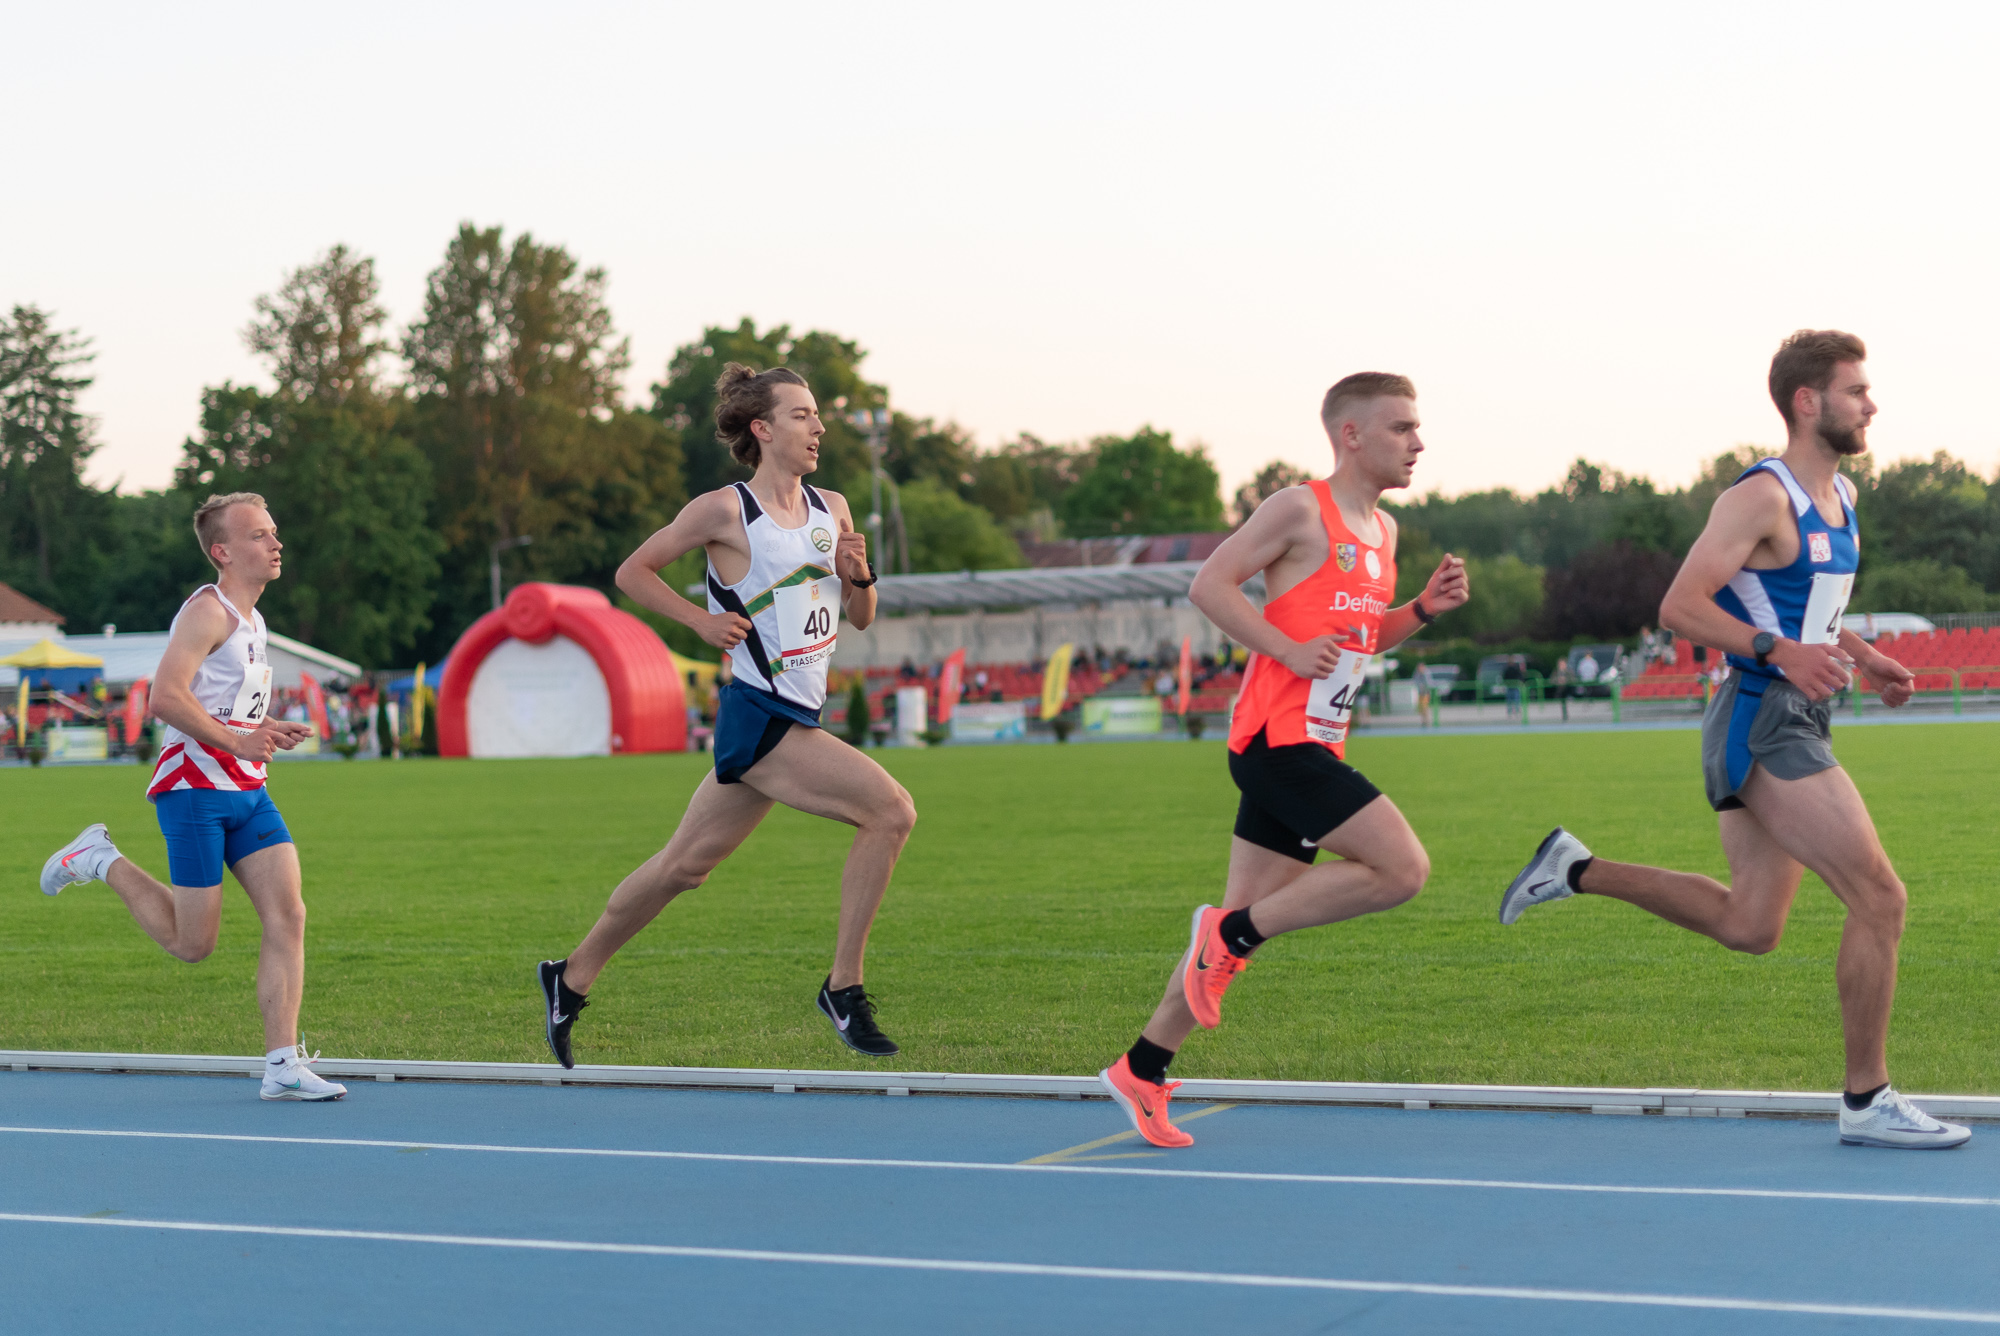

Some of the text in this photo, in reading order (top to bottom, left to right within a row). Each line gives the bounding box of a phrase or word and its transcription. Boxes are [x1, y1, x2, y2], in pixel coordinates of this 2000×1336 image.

[813, 531, 828, 542] RKS
[804, 606, 830, 640] 40
[1826, 606, 1844, 640] 4
[247, 692, 267, 719] 26
